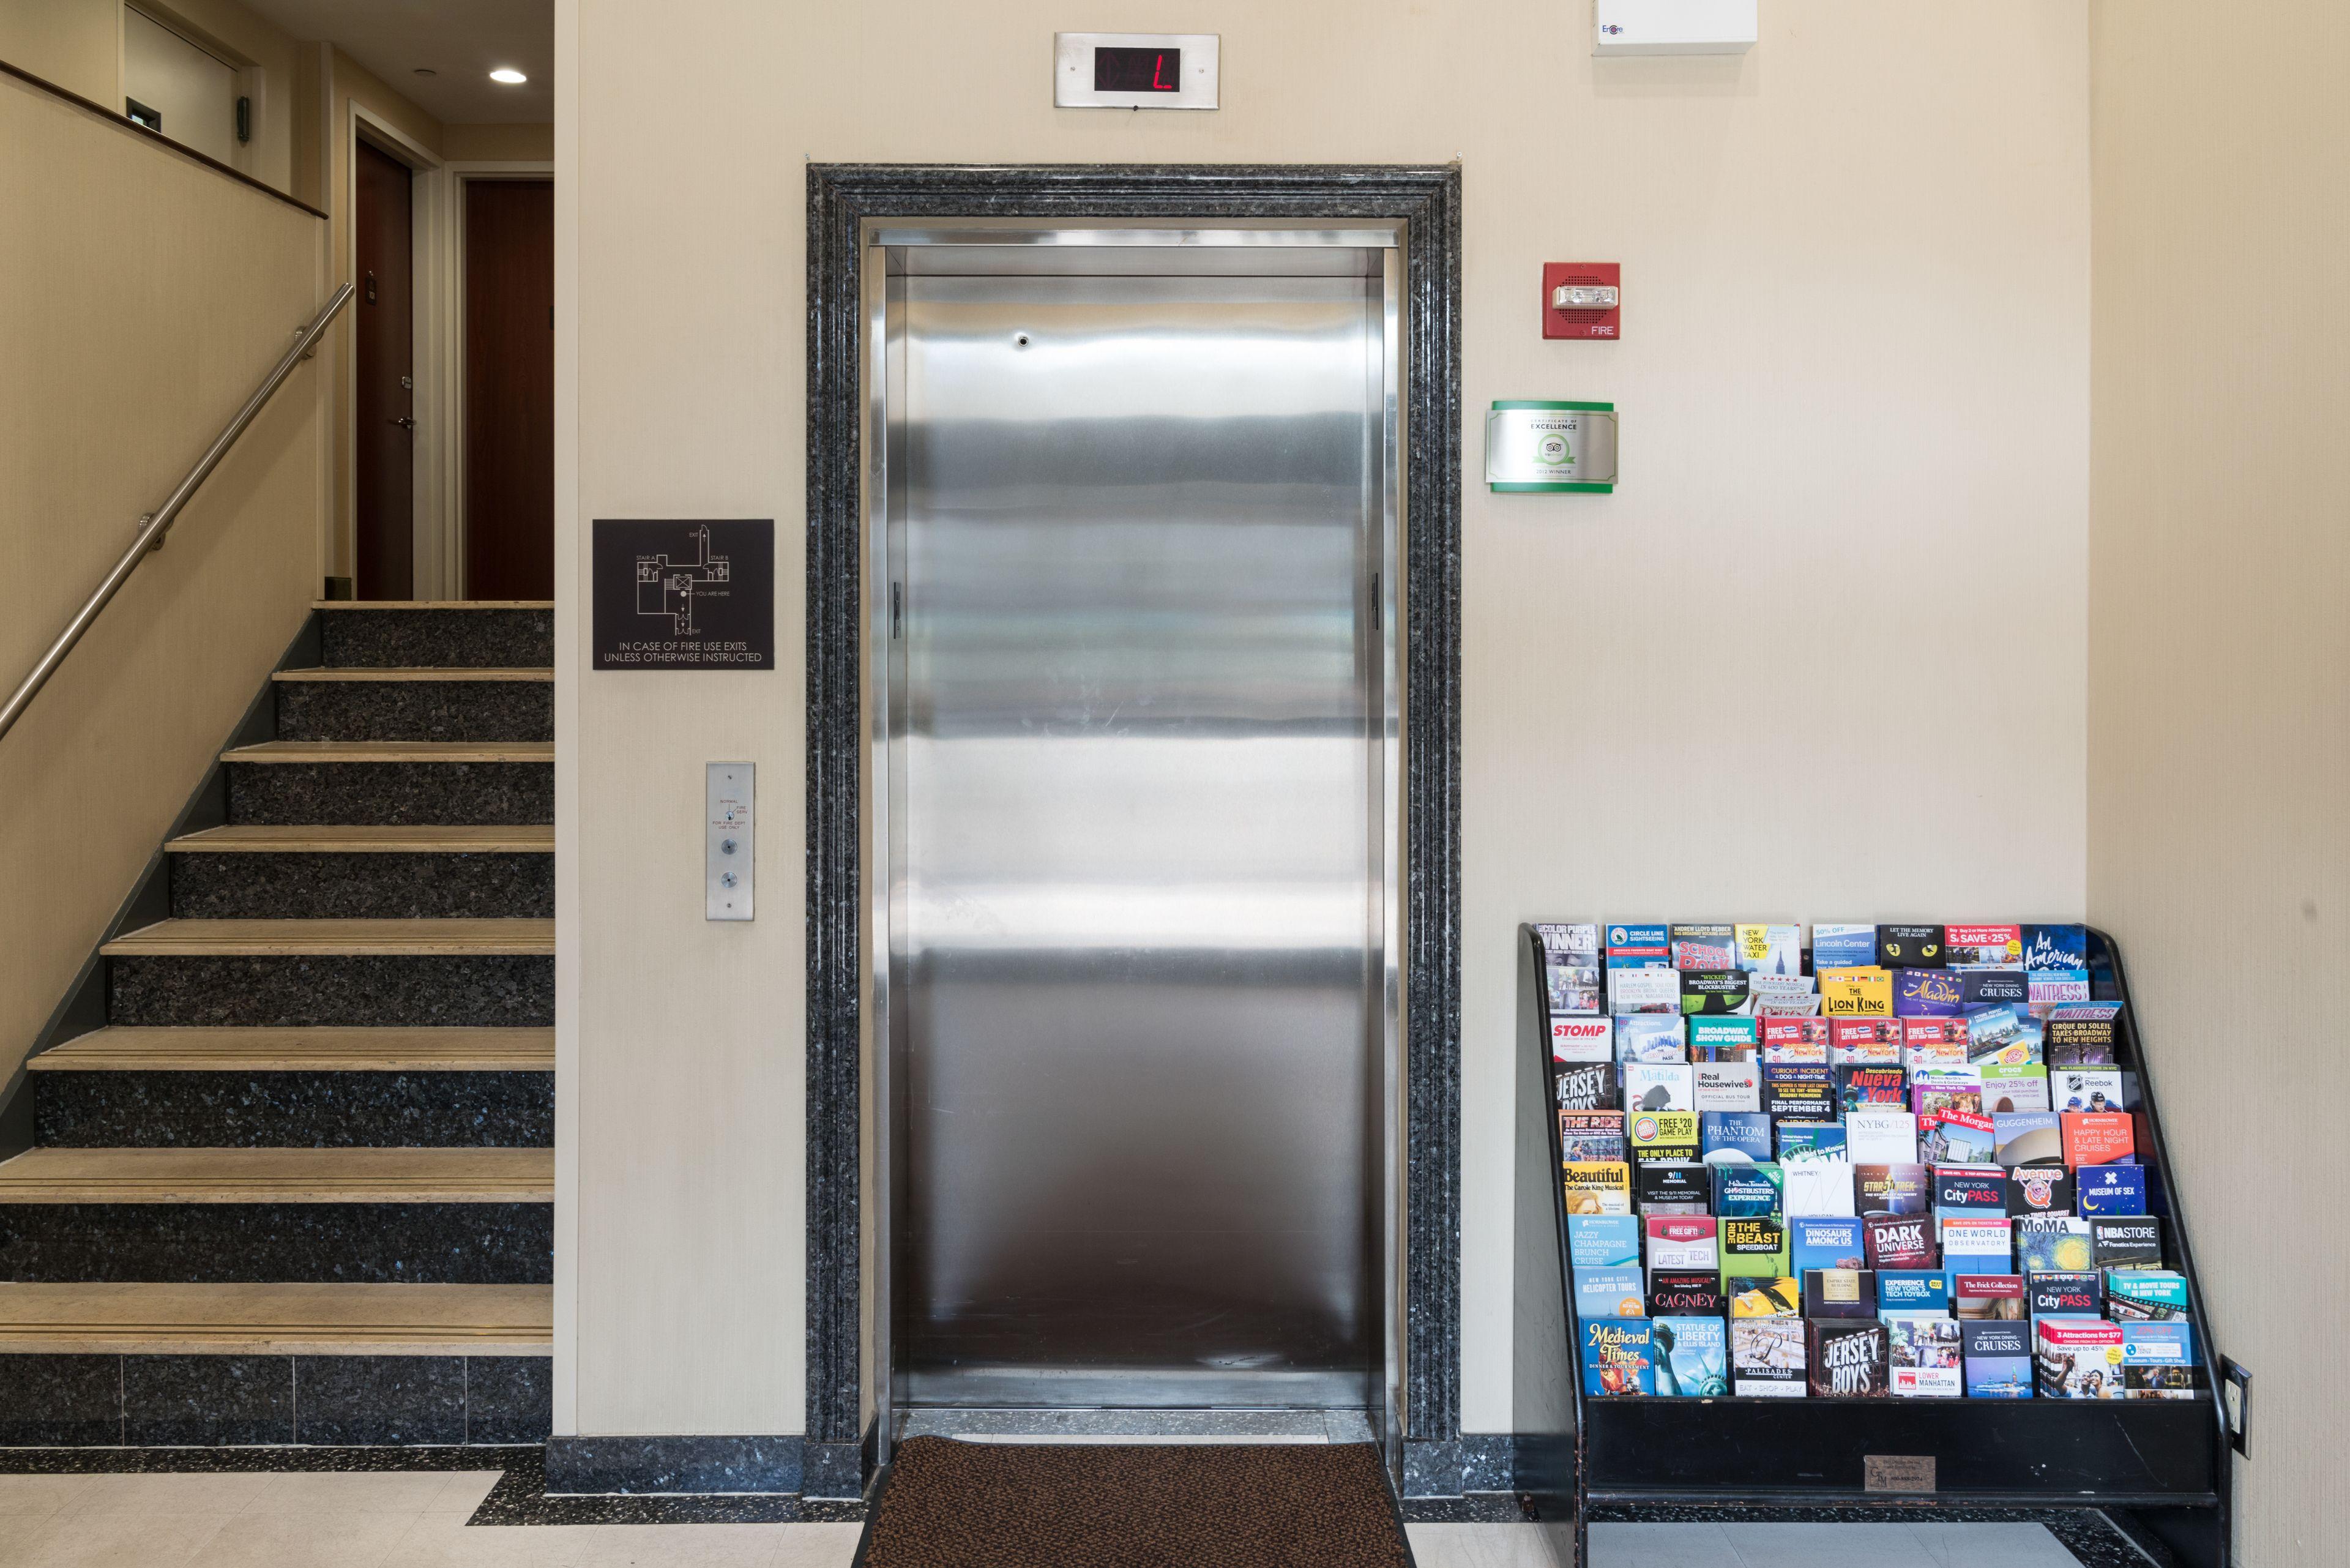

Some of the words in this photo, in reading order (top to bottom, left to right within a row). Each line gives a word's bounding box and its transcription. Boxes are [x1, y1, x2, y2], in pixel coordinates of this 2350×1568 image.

[1154, 55, 1172, 89] L
[1591, 326, 1614, 335] FIRE
[619, 642, 630, 651] IN
[633, 642, 660, 651] CASE
[663, 642, 677, 651] OF
[704, 642, 721, 651] USE
[725, 642, 747, 651] EXITS
[605, 653, 640, 662] UNLESS
[644, 653, 700, 662] OTHERWISE
[703, 653, 761, 662] INSTRUCTED
[1541, 925, 1567, 934] COLOR
[1542, 934, 1596, 950] WINNER!
[1961, 934, 1987, 943] SAVE
[1991, 933, 2011, 943] 25%
[1679, 941, 1729, 957] SCHOOL
[1679, 955, 1729, 969] ROCK
[1980, 988, 2022, 997] CRUISES
[1828, 997, 1854, 1012] LION
[1857, 997, 1884, 1012] KING
[1553, 1025, 1606, 1037] STOMP
[1640, 1069, 1679, 1081] Matilda
[1851, 1071, 1901, 1087] Nueva
[1867, 1087, 1903, 1102] York
[1659, 1119, 1677, 1128] FREE
[1680, 1118, 1692, 1127] $20
[1940, 1108, 1958, 1120] The
[1960, 1113, 1994, 1129] Morgan
[1996, 1118, 2053, 1127] GUGGENHEIM
[1707, 1126, 1765, 1137] PHANTOM
[1564, 1168, 1624, 1183] Beautiful
[1944, 1189, 1999, 1204] CityPASS
[2089, 1187, 2113, 1196] MUSEUM
[1727, 1222, 1736, 1244] RIDE
[1737, 1223, 1761, 1233] THE
[2020, 1219, 2069, 1233] MoMA
[1736, 1233, 1780, 1244] BEAST
[1874, 1225, 1923, 1244] DARK
[1876, 1239, 1925, 1253] UNIVERSE
[1655, 1293, 1717, 1308] CAGNEY
[1588, 1323, 1650, 1346] Medieval
[1676, 1332, 1720, 1341] LIBERTY
[1599, 1343, 1641, 1364] Times
[1824, 1334, 1879, 1368] JERSEY
[1832, 1364, 1871, 1394] BOYS
